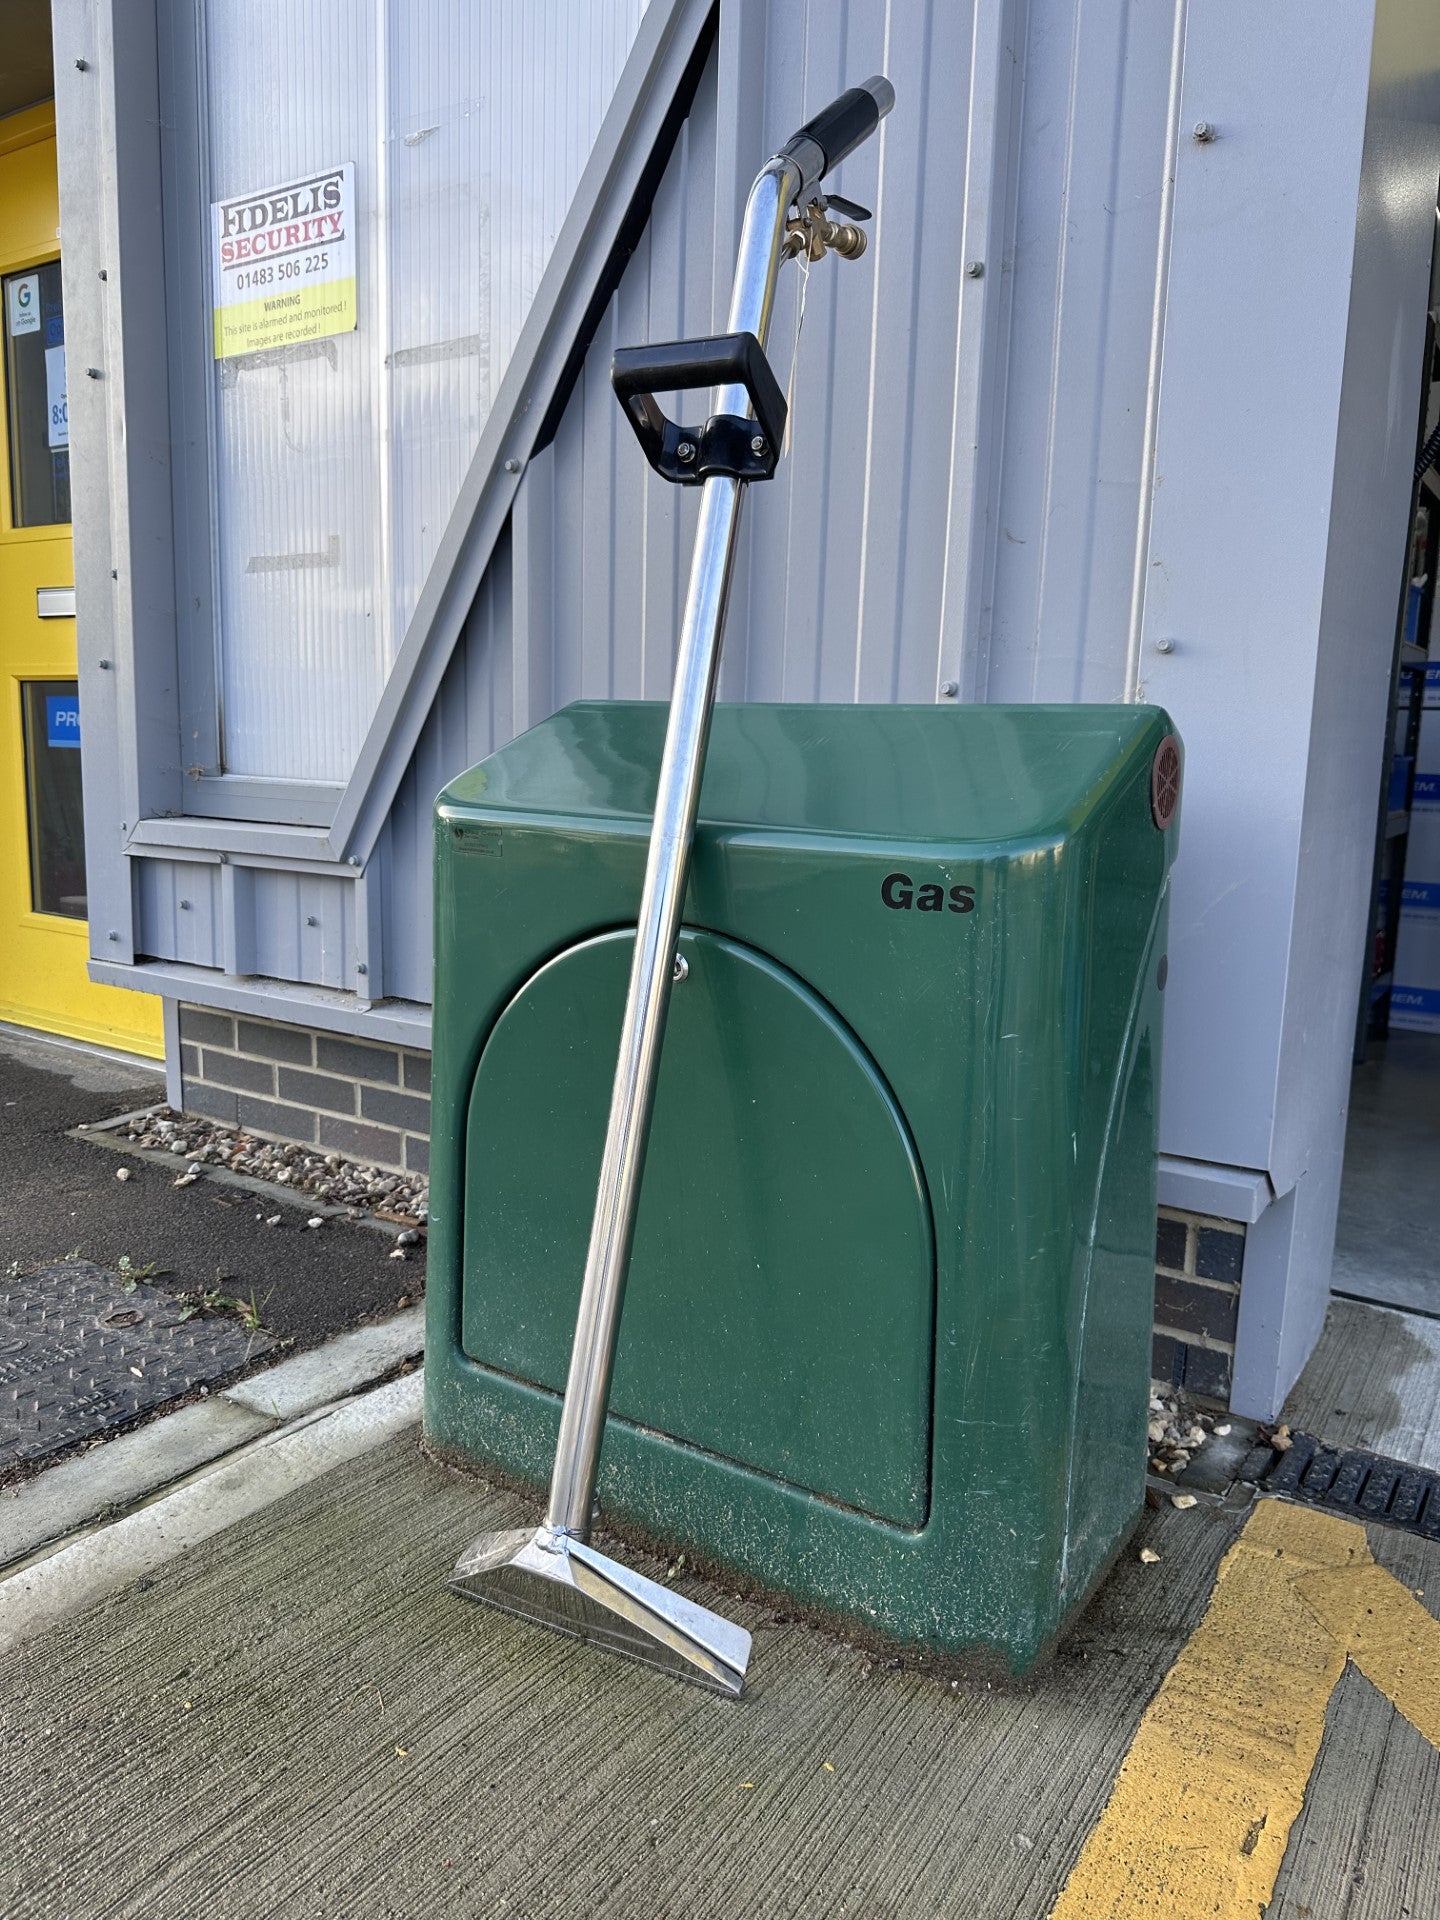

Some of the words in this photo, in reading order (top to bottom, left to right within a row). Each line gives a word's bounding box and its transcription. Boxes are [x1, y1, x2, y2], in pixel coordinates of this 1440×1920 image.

[221, 179, 341, 238] FIDELIS
[221, 210, 344, 264] SECURITY
[237, 268, 274, 290] 01483
[278, 260, 301, 281] 506
[305, 252, 329, 274] 225
[264, 295, 301, 312] WARNING
[224, 325, 238, 337] This
[239, 324, 251, 334] site
[259, 313, 287, 329] alarmed
[289, 310, 302, 323] and
[247, 334, 271, 348] Images
[273, 332, 283, 342] are
[881, 872, 976, 914] Gas
